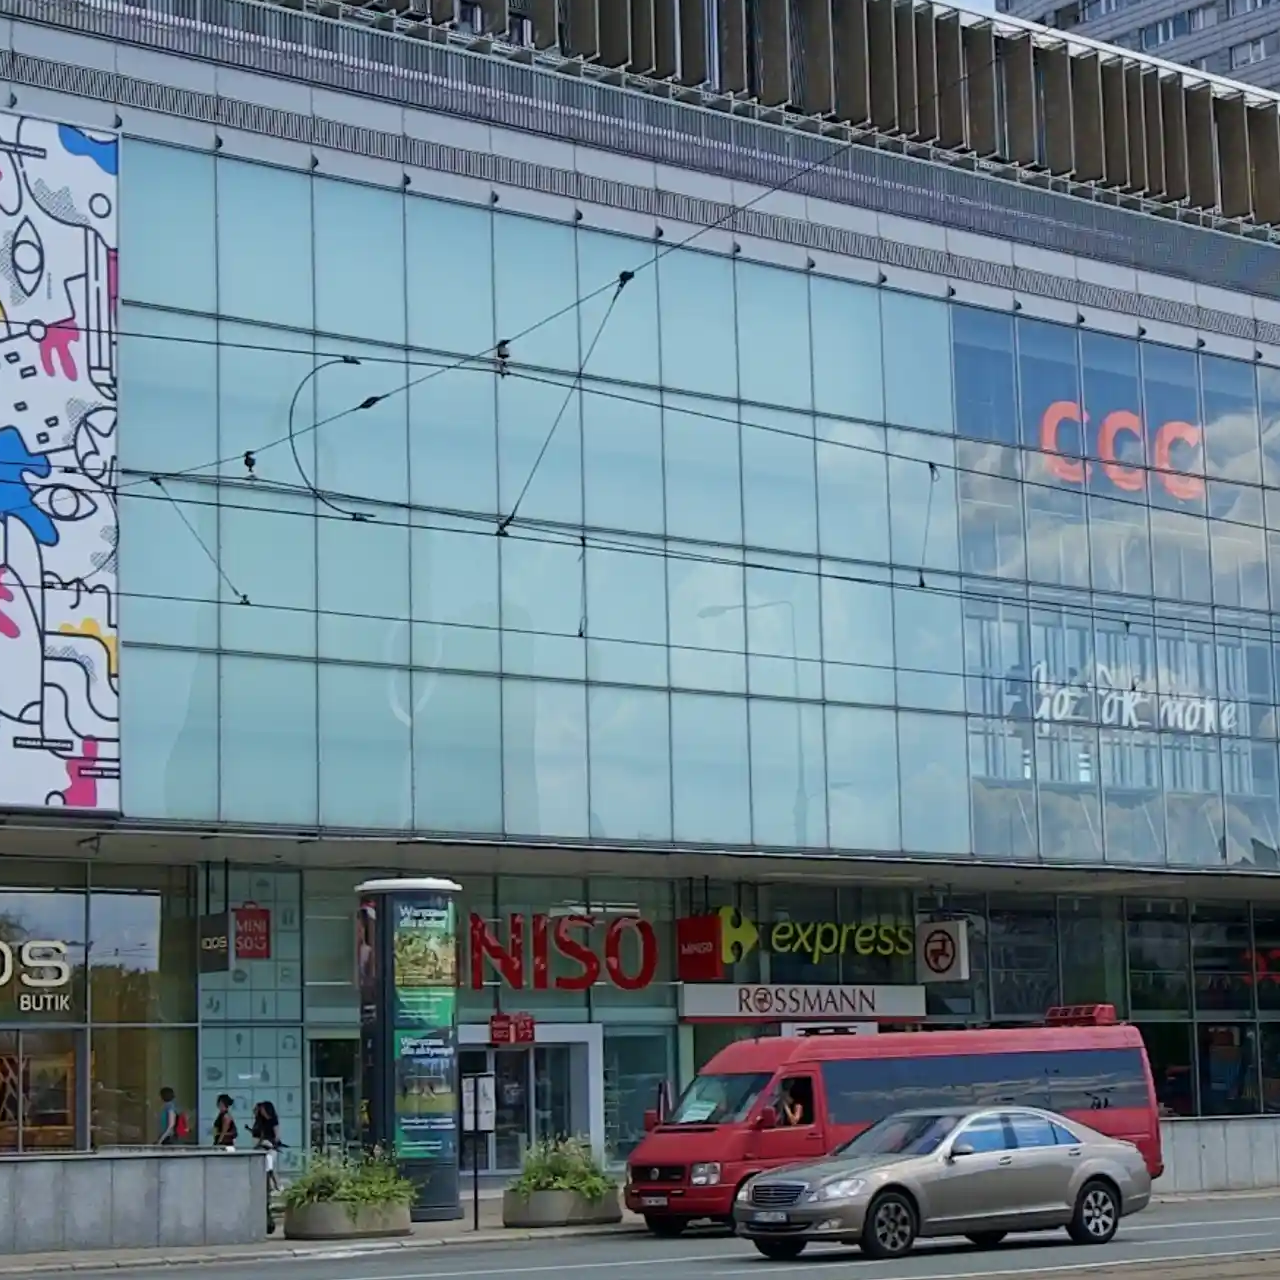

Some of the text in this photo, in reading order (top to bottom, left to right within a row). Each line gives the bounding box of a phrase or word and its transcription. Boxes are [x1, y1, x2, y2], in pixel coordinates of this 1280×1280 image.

[1040, 399, 1205, 501] CCC
[771, 919, 913, 964] express
[20, 994, 70, 1012] BUTIK
[738, 987, 876, 1013] ROSSMANN
